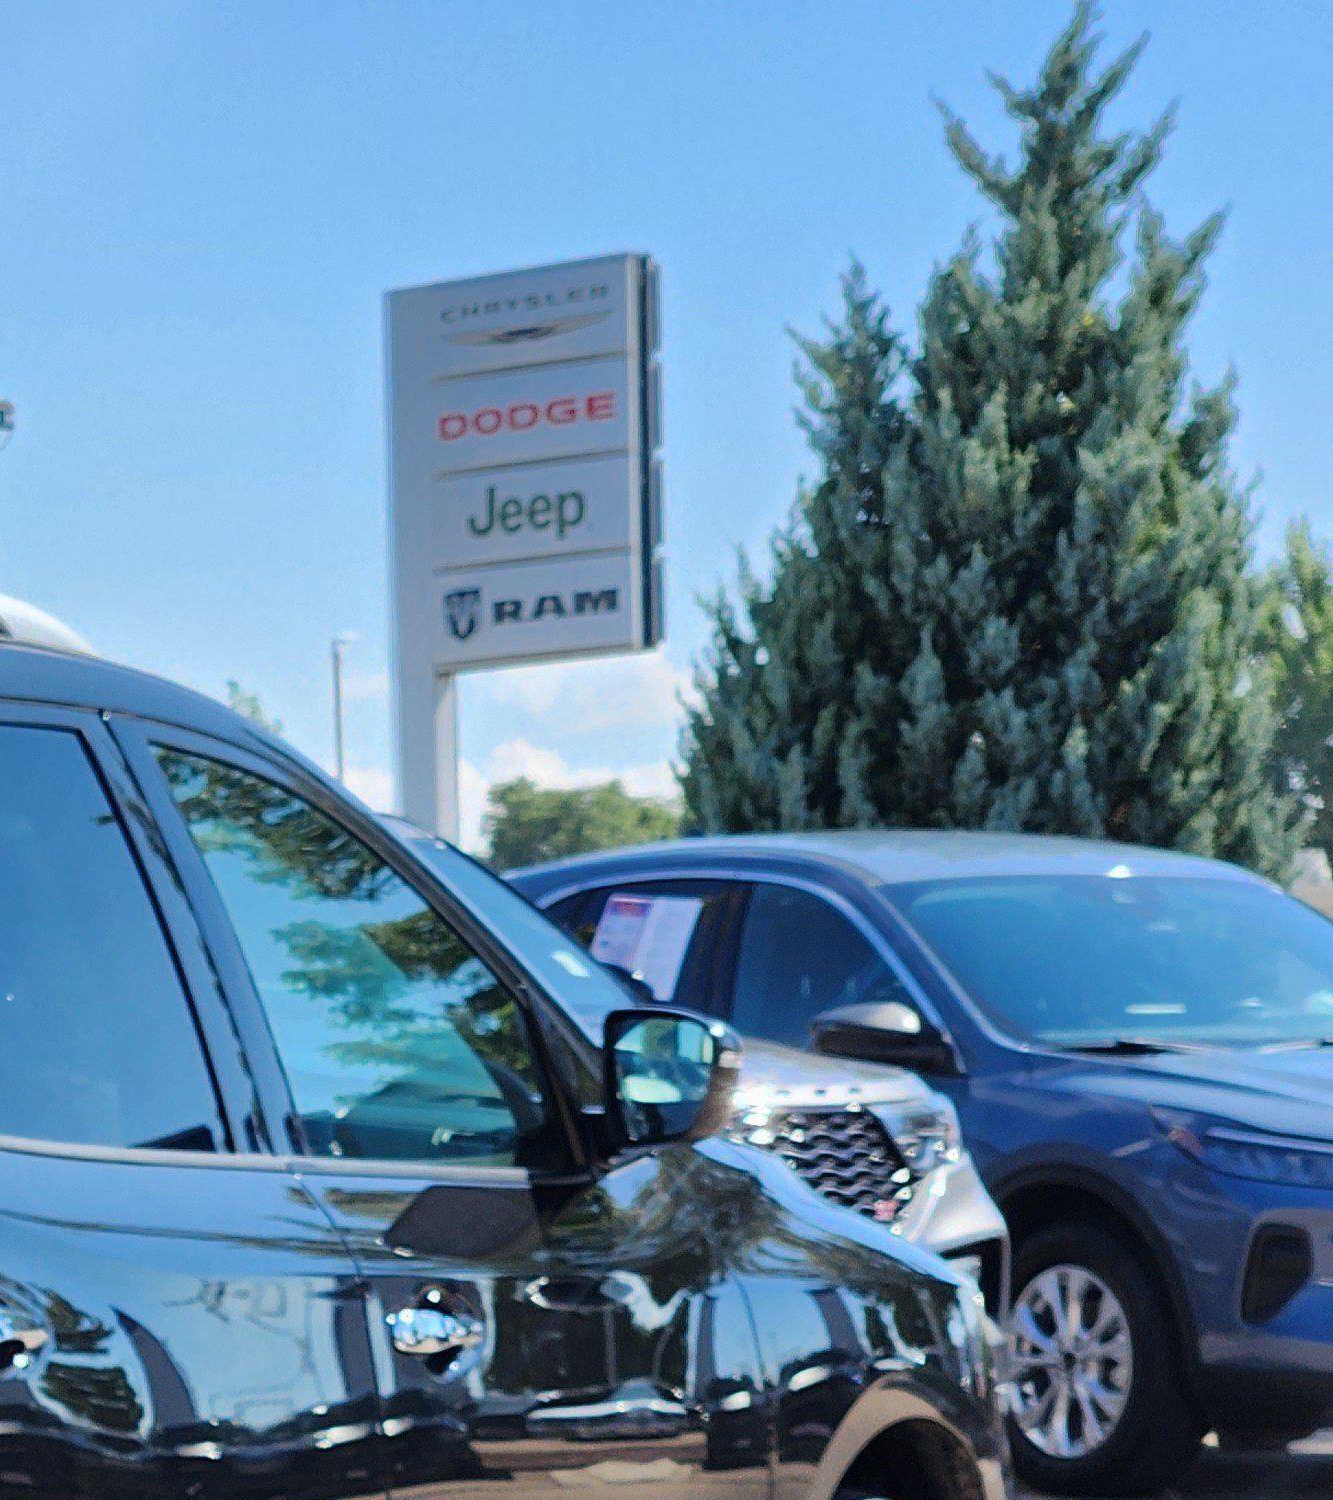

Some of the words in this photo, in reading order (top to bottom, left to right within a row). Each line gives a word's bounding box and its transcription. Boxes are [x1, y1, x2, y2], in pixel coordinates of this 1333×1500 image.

[440, 284, 609, 324] CHRYSLER
[438, 392, 617, 441] DODGE
[468, 487, 585, 539] Jeep
[493, 588, 620, 626] RAM
